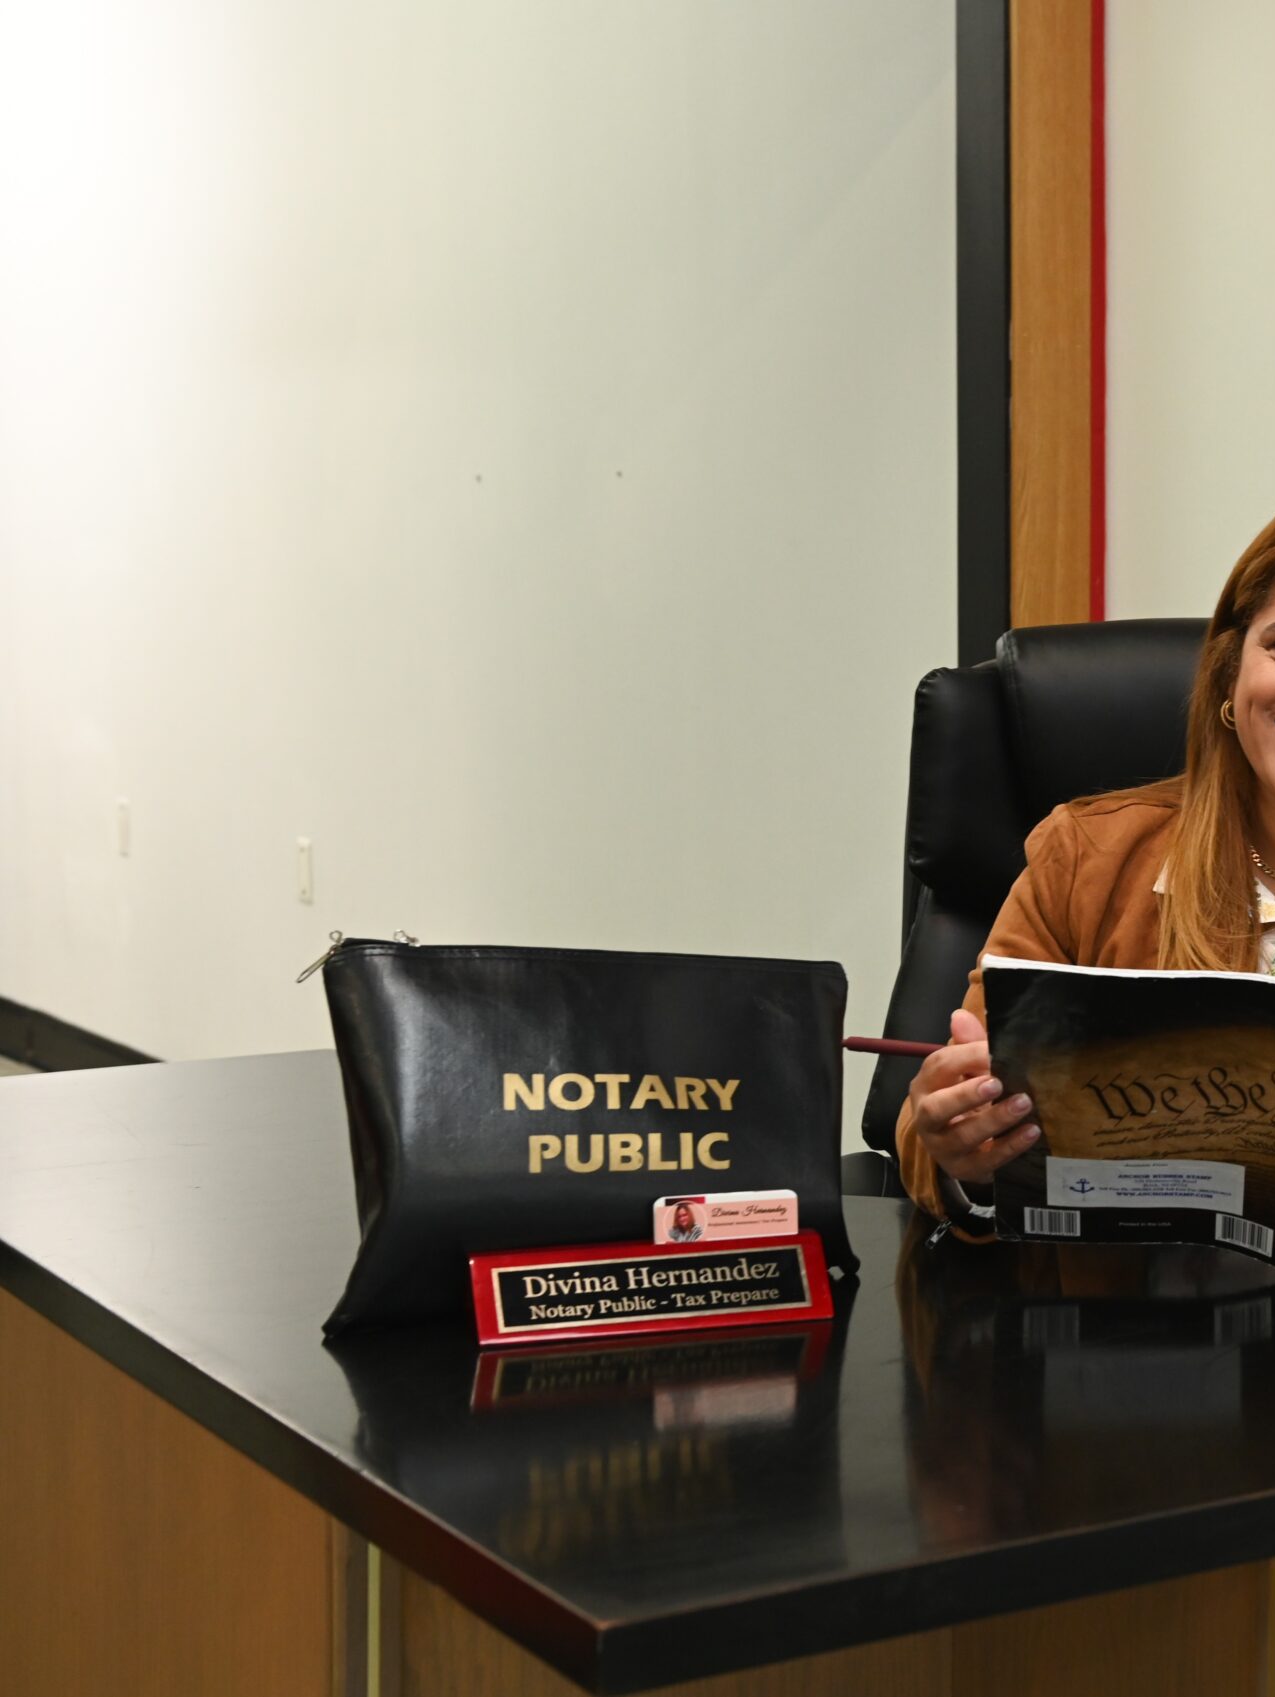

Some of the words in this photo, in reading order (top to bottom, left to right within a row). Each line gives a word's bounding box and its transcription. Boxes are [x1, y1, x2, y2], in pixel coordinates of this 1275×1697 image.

[503, 1073, 740, 1111] NOTARY
[1084, 1073, 1194, 1126] We
[528, 1132, 731, 1174] PUBLIC
[522, 1271, 619, 1299] Divina
[624, 1258, 780, 1290] Hernandez
[530, 1302, 595, 1320] Notary
[598, 1296, 657, 1315] Public
[671, 1293, 706, 1308] Tax
[711, 1286, 780, 1306] Prepare
